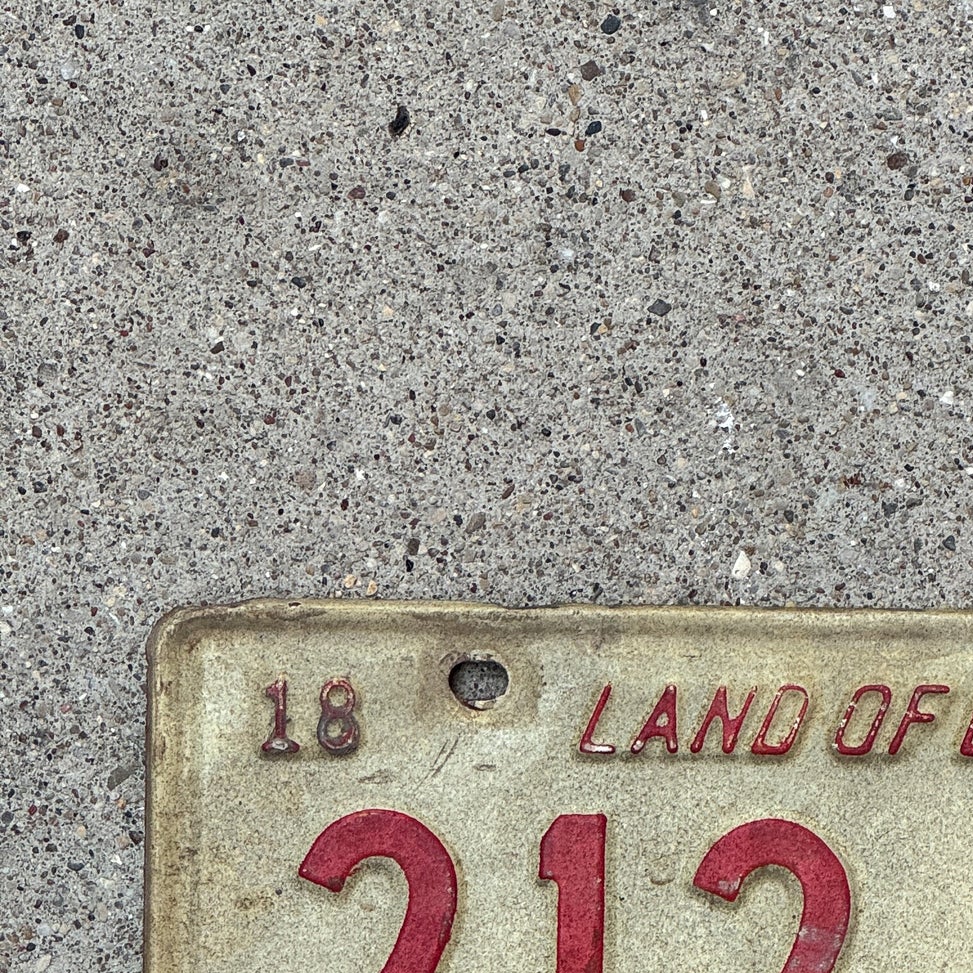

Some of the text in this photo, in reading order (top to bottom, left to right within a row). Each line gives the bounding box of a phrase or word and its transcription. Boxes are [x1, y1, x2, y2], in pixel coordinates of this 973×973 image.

[262, 677, 362, 756] 18
[579, 684, 810, 757] LAND
[835, 684, 950, 758] OF
